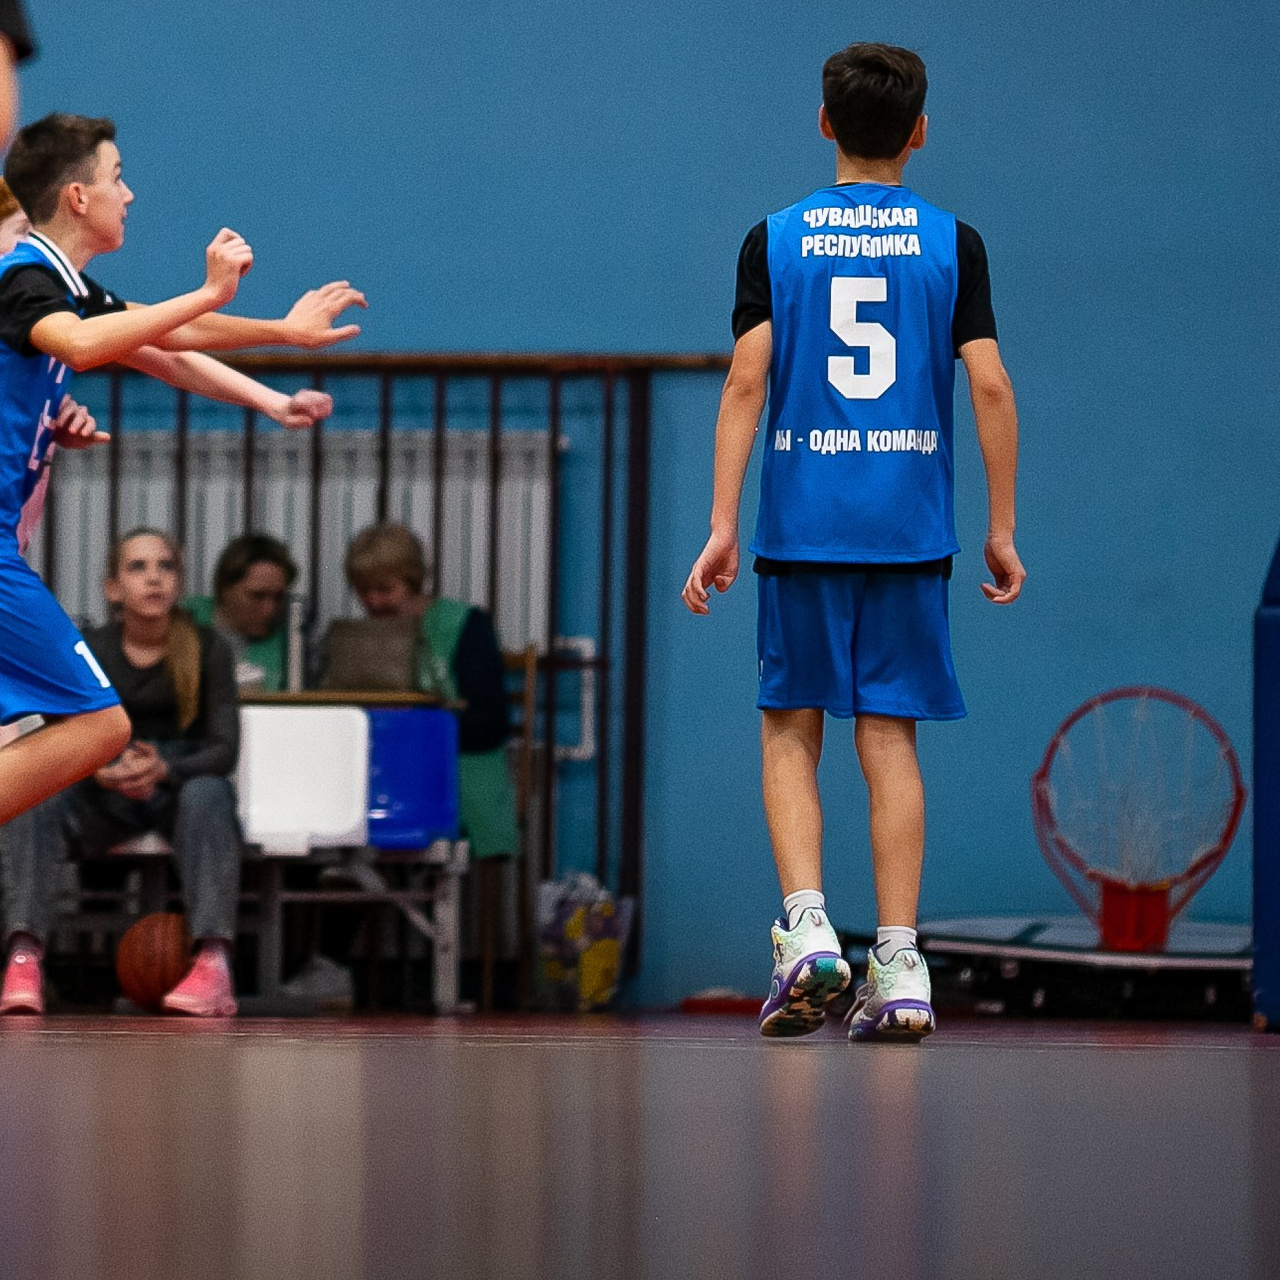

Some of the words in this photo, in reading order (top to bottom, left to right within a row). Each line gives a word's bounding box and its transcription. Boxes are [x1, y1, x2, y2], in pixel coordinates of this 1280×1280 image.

[801, 234, 921, 258] РЕСПУБЛИКА
[828, 277, 896, 399] 5
[809, 429, 861, 455] ОДНА
